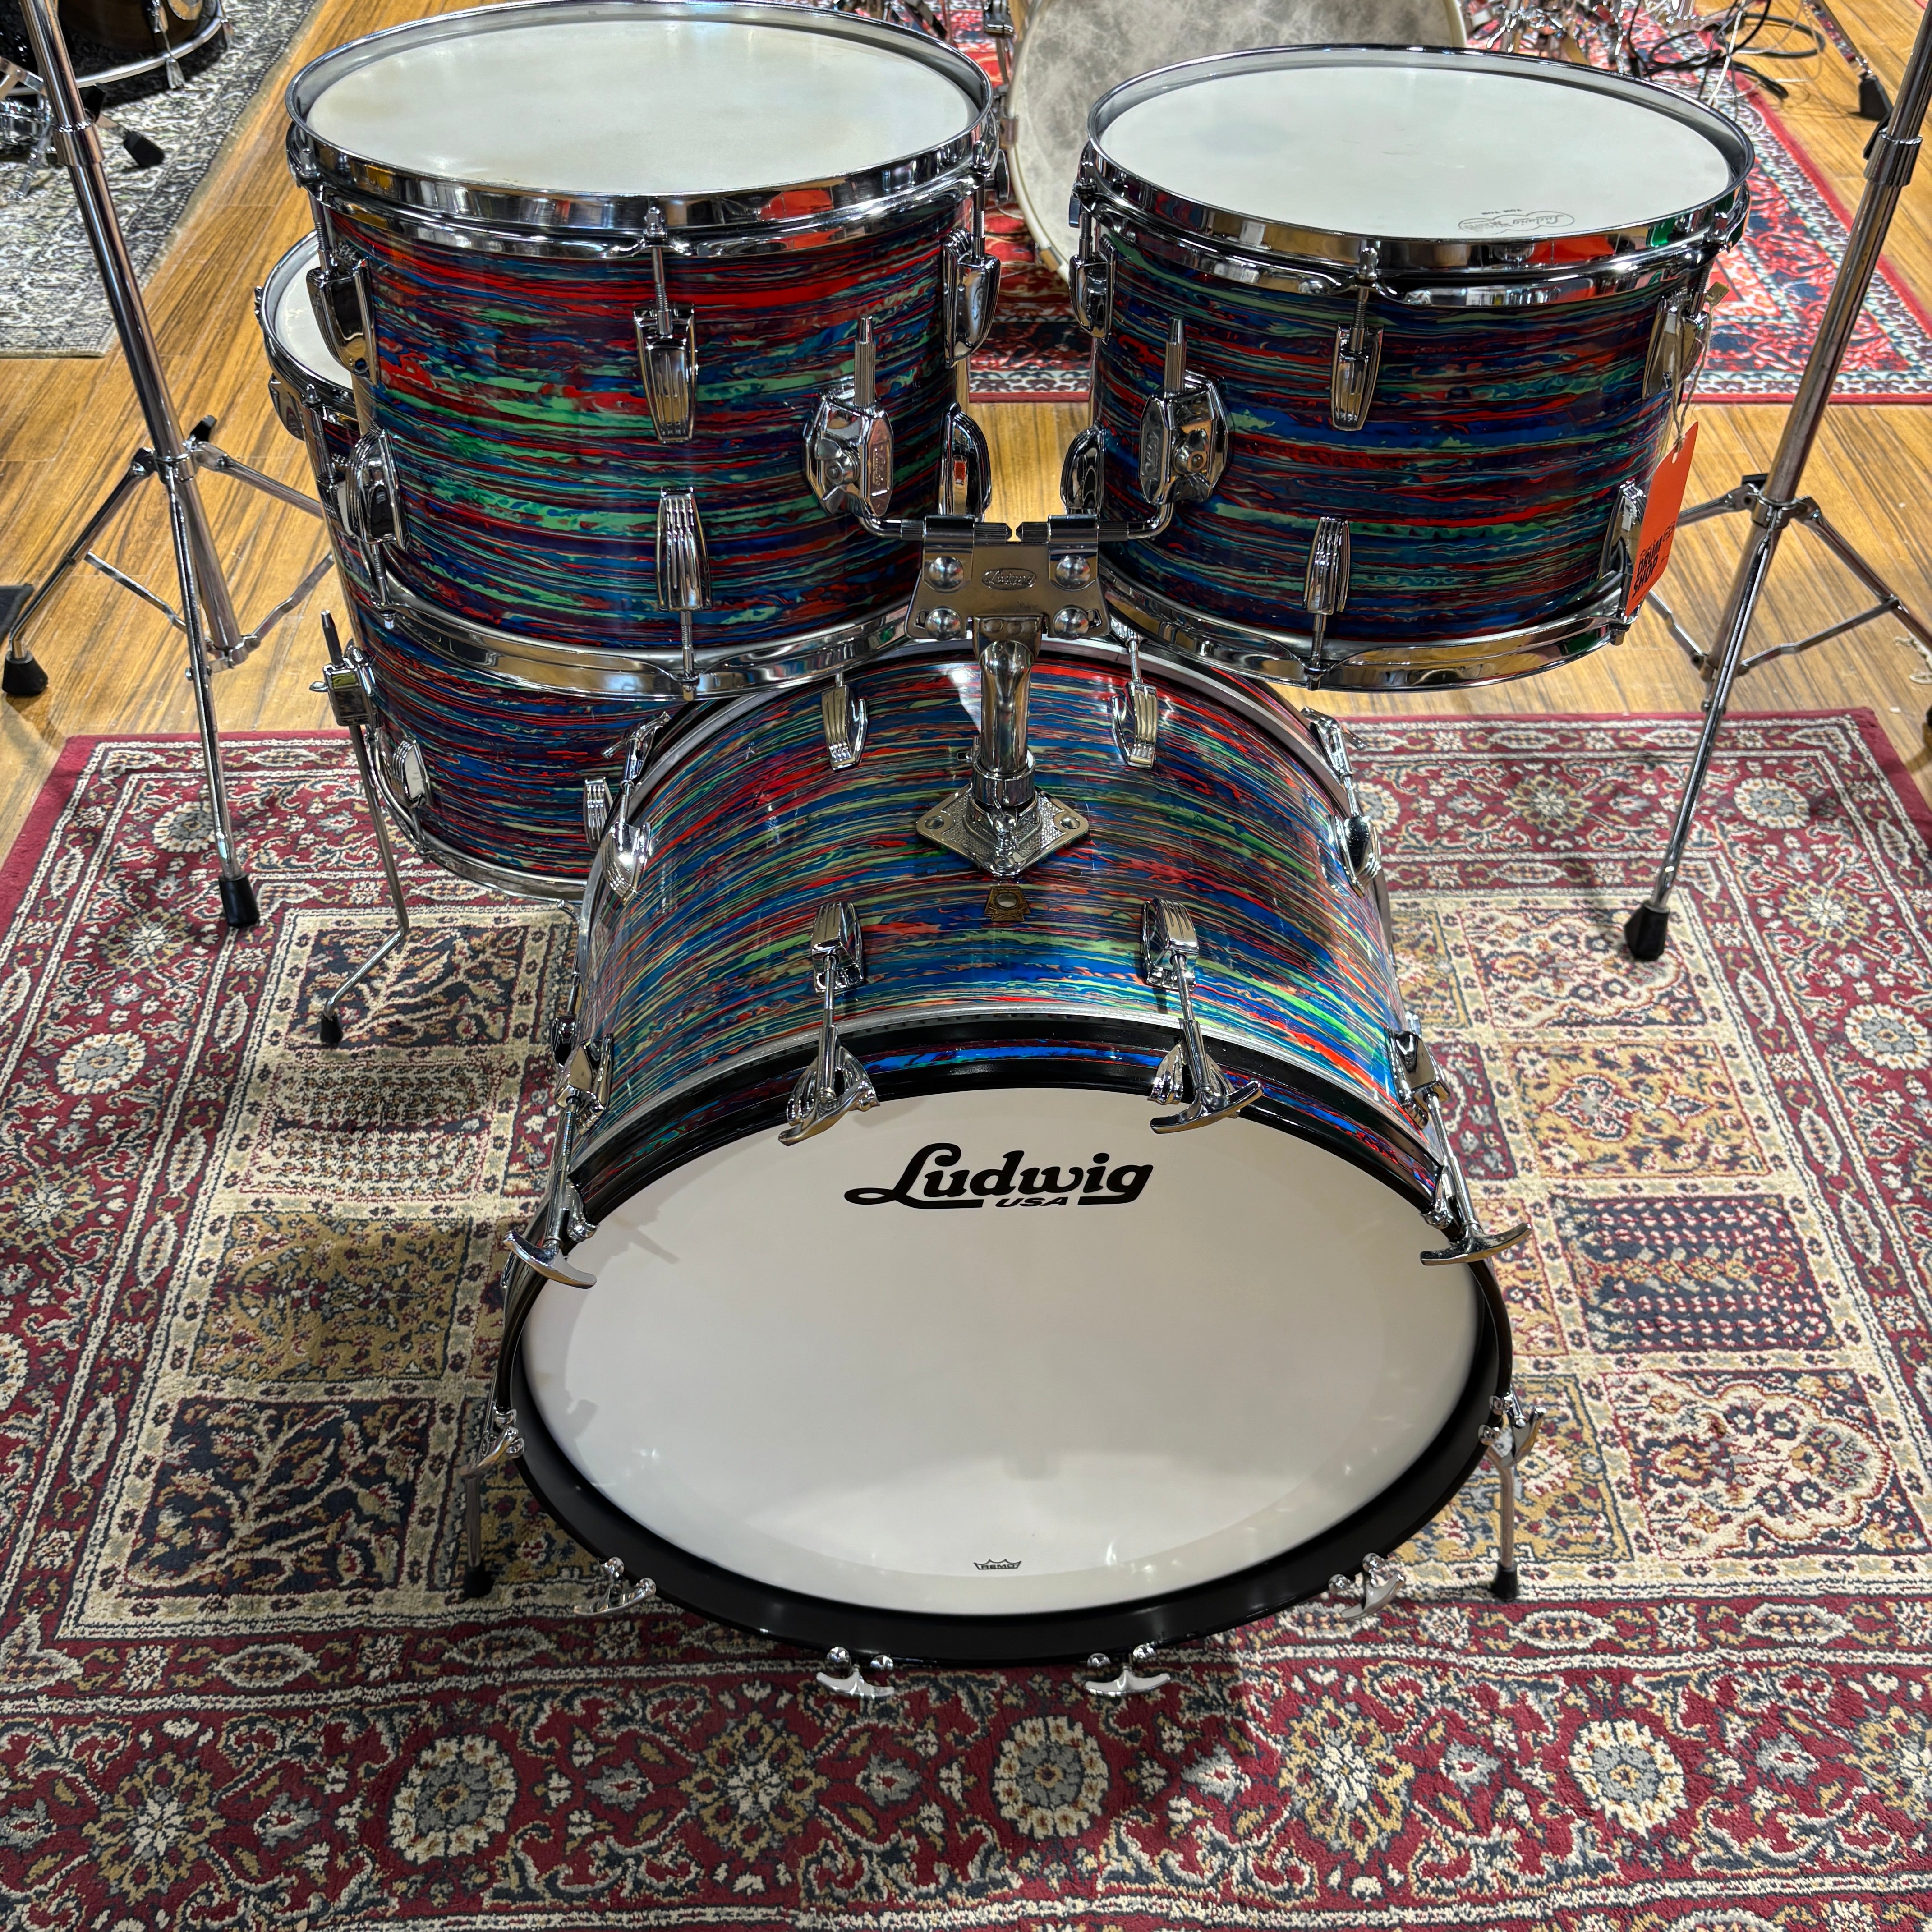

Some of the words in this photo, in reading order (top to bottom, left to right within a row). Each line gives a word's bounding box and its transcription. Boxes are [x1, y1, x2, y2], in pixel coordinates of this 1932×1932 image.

[1513, 214, 1564, 225] Ludwig
[1632, 554, 1659, 599] SHOP
[1637, 536, 1663, 578] DRUM
[844, 1142, 1154, 1209] Ludwig
[995, 1196, 1069, 1207] USA
